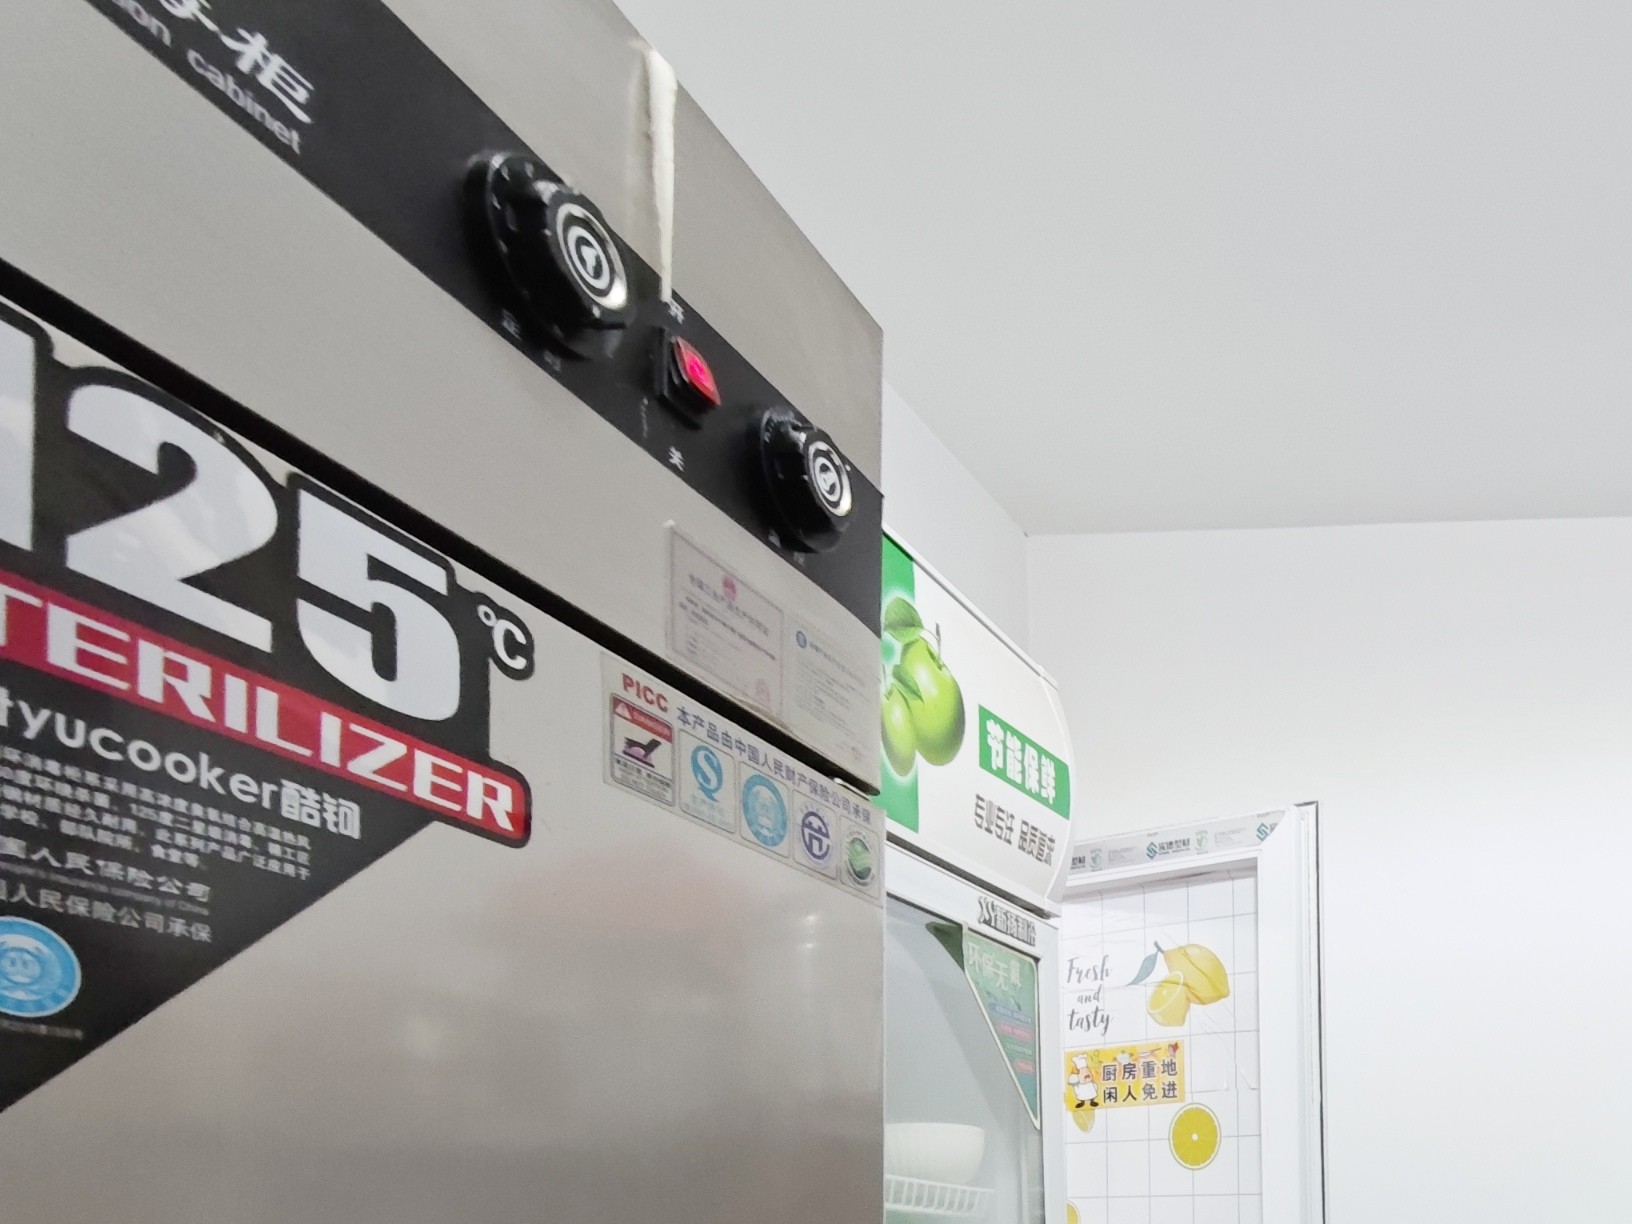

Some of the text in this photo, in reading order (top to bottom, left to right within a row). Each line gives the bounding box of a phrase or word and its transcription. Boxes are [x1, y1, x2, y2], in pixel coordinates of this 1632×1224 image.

[622, 673, 669, 713] PICC
[986, 718, 1057, 806] 节能保鲜
[1067, 954, 1112, 984] Fresh
[1077, 984, 1103, 1004] and
[1068, 1006, 1114, 1036] tasty
[1102, 1058, 1178, 1082] 厨房重地
[1103, 1081, 1178, 1104] 闲人免进
